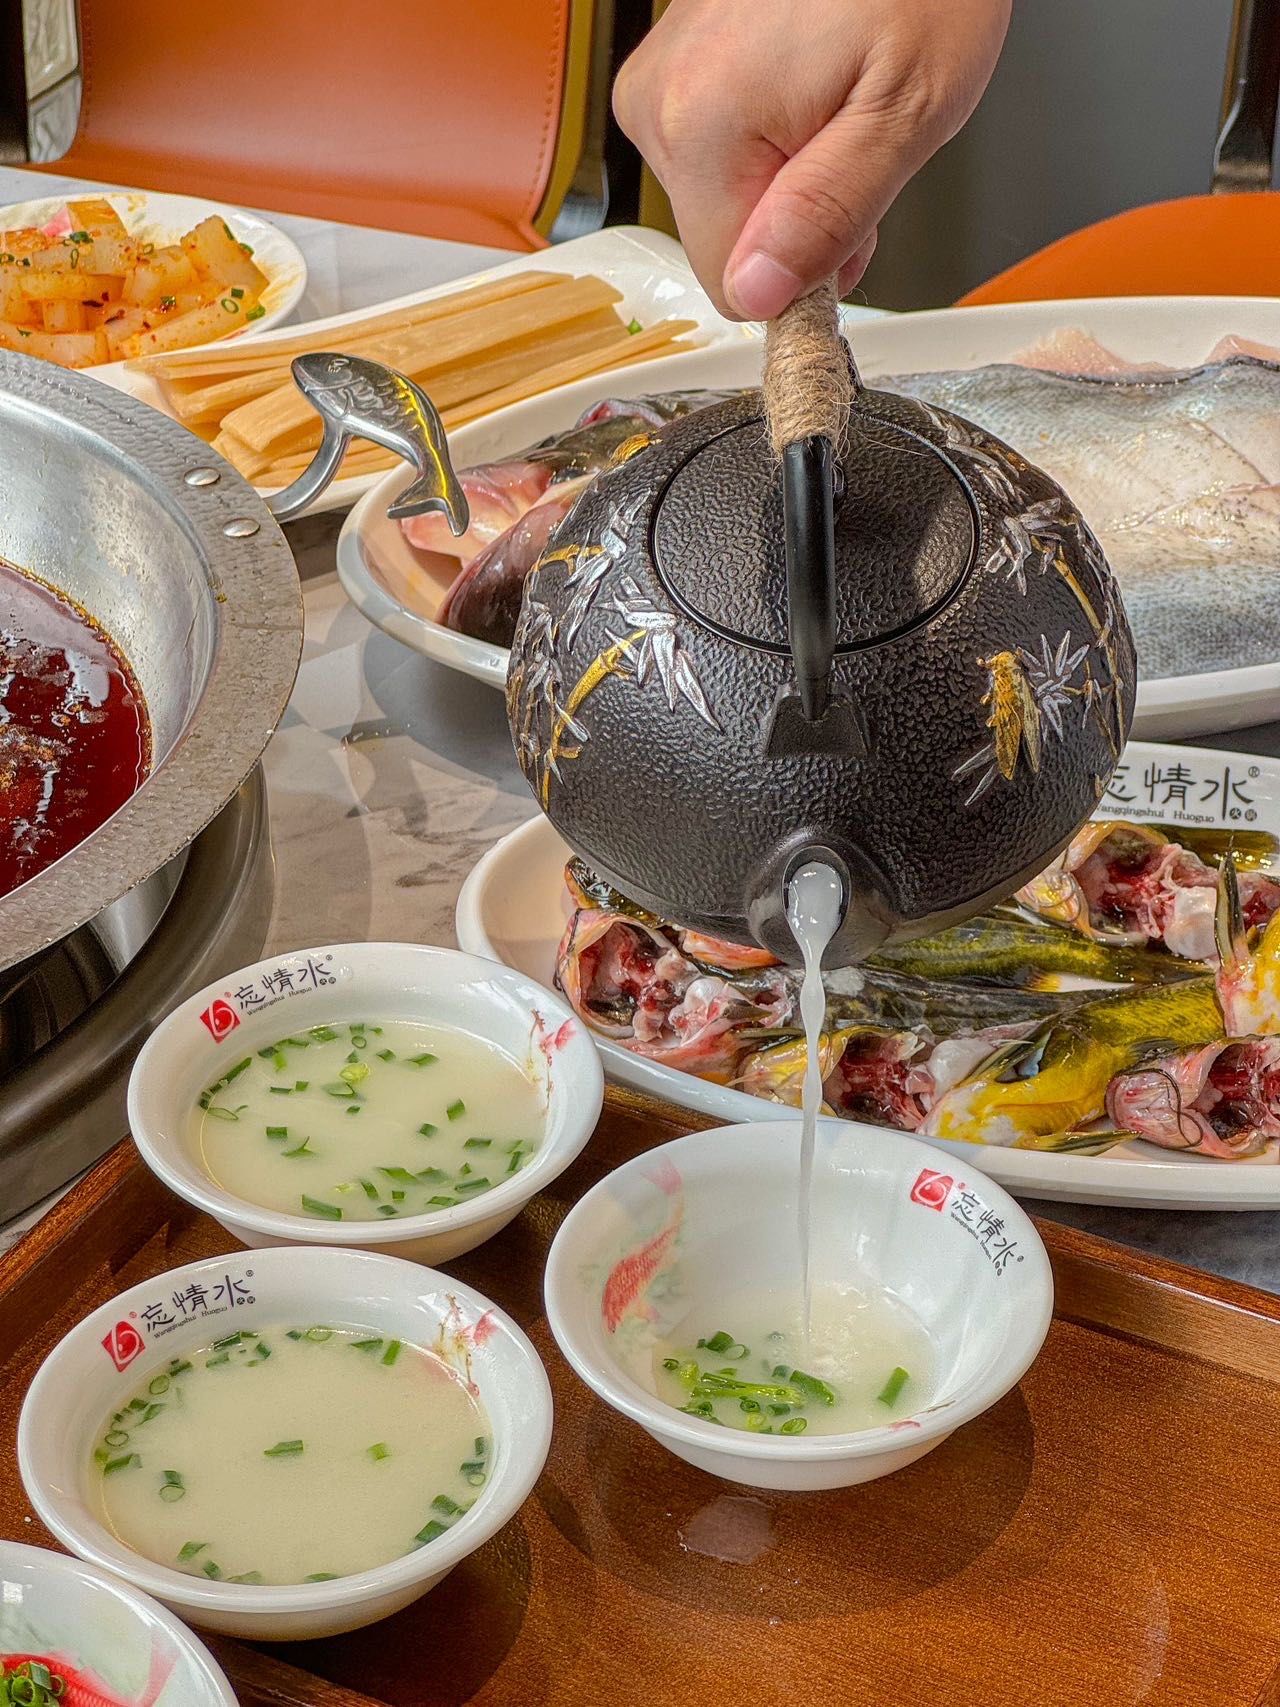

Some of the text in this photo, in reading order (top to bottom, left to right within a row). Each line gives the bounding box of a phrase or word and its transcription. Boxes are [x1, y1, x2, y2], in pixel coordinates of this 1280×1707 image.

[1096, 803, 1215, 824] angqingshui Huoguo
[234, 959, 331, 1010] 忘情水
[951, 1191, 1018, 1267] 忘情水
[140, 1274, 250, 1333] 忘情水
